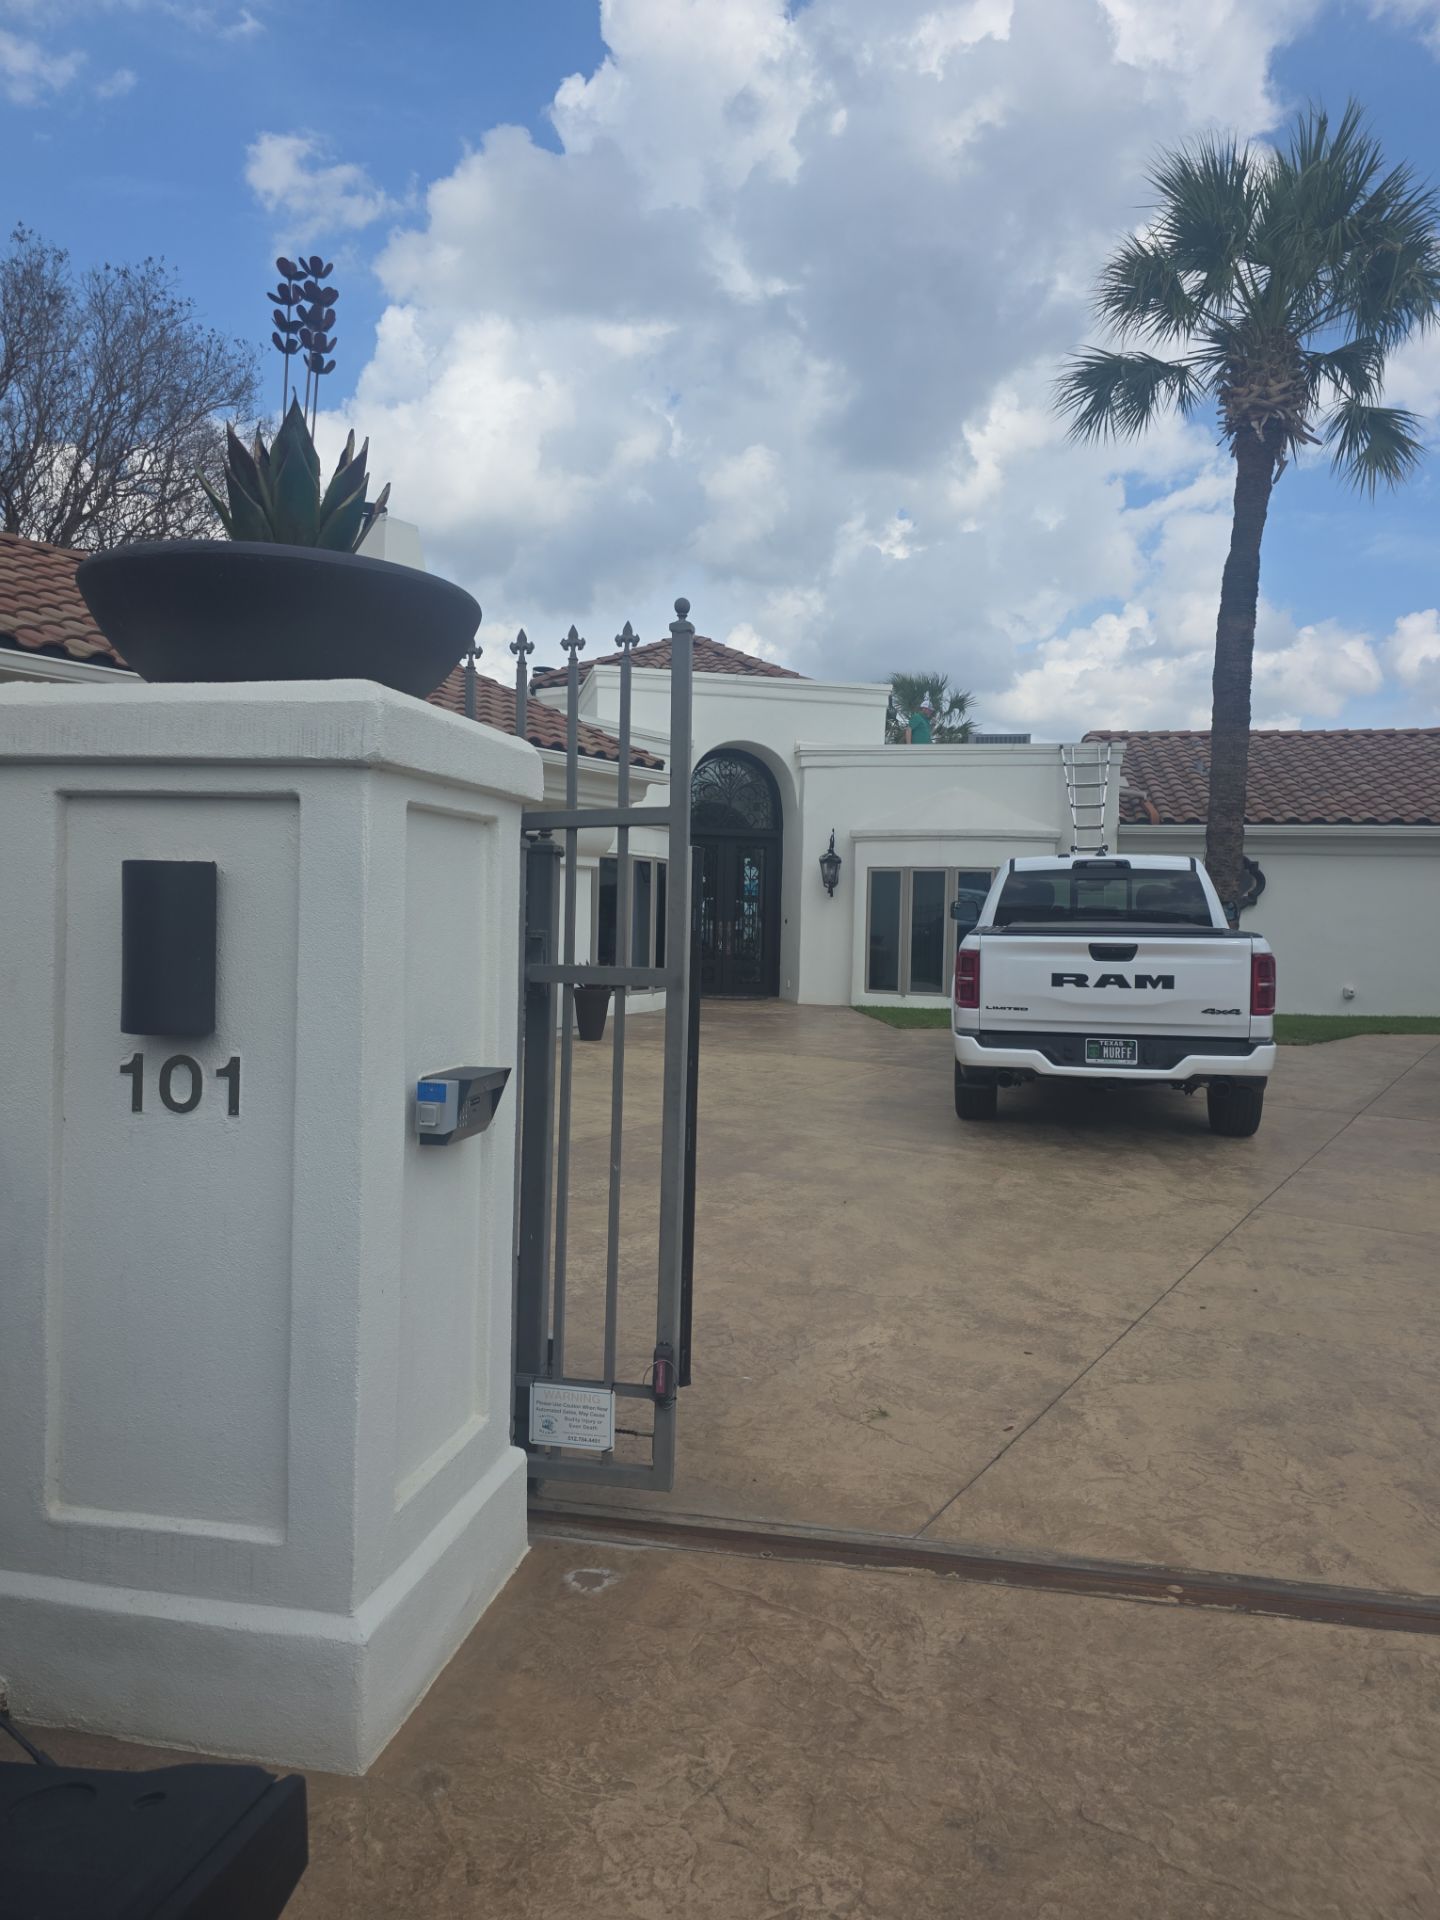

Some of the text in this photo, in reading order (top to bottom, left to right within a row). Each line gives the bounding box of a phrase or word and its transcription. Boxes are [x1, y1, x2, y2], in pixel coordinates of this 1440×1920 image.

[1051, 972, 1175, 990] RAM
[1201, 1008, 1242, 1016] 4x4
[1103, 1046, 1133, 1059] MURFF
[120, 1053, 240, 1116] 101
[544, 1389, 601, 1404] WARNING
